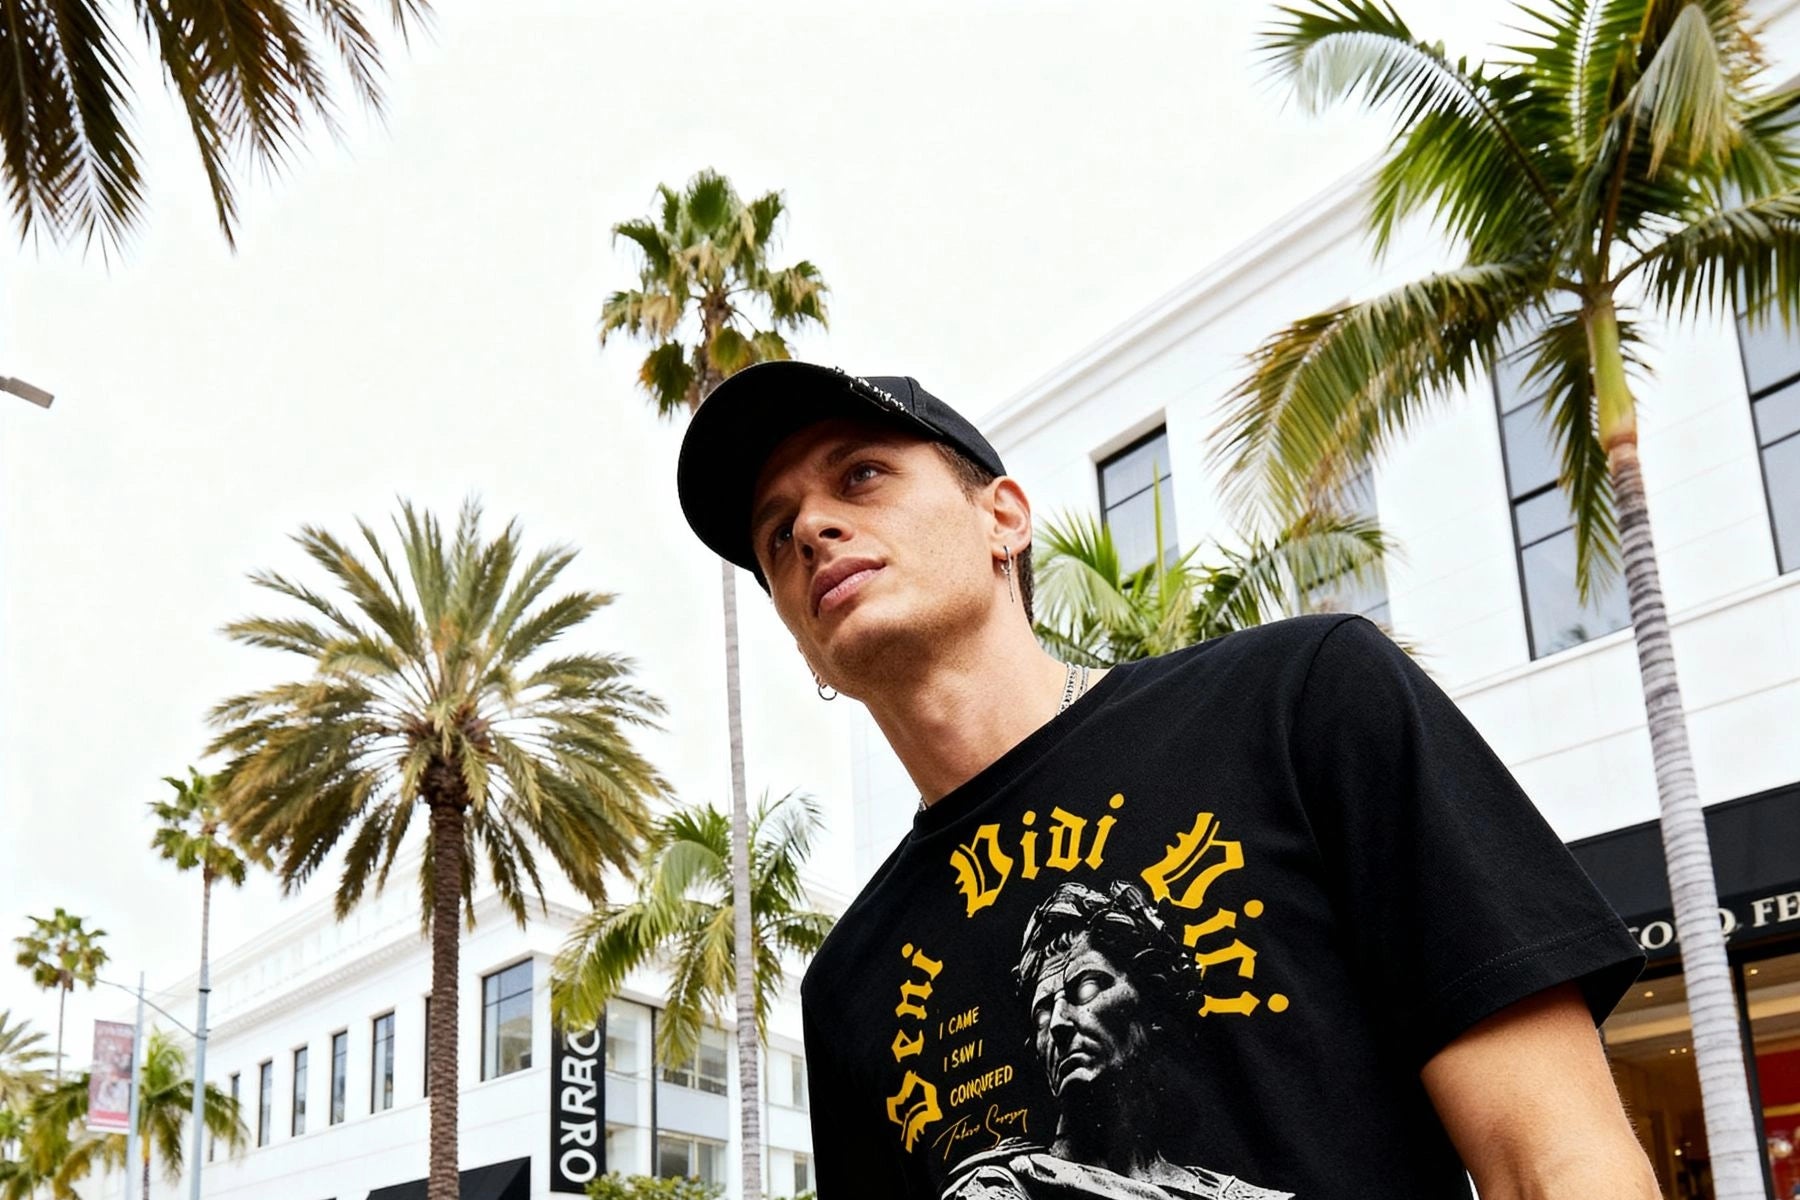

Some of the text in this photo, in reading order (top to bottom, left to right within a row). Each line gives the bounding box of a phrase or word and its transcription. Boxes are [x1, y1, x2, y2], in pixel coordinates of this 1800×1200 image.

[949, 793, 1125, 918] Vidi
[948, 1005, 980, 1036] CAME
[951, 1040, 976, 1069] SAW
